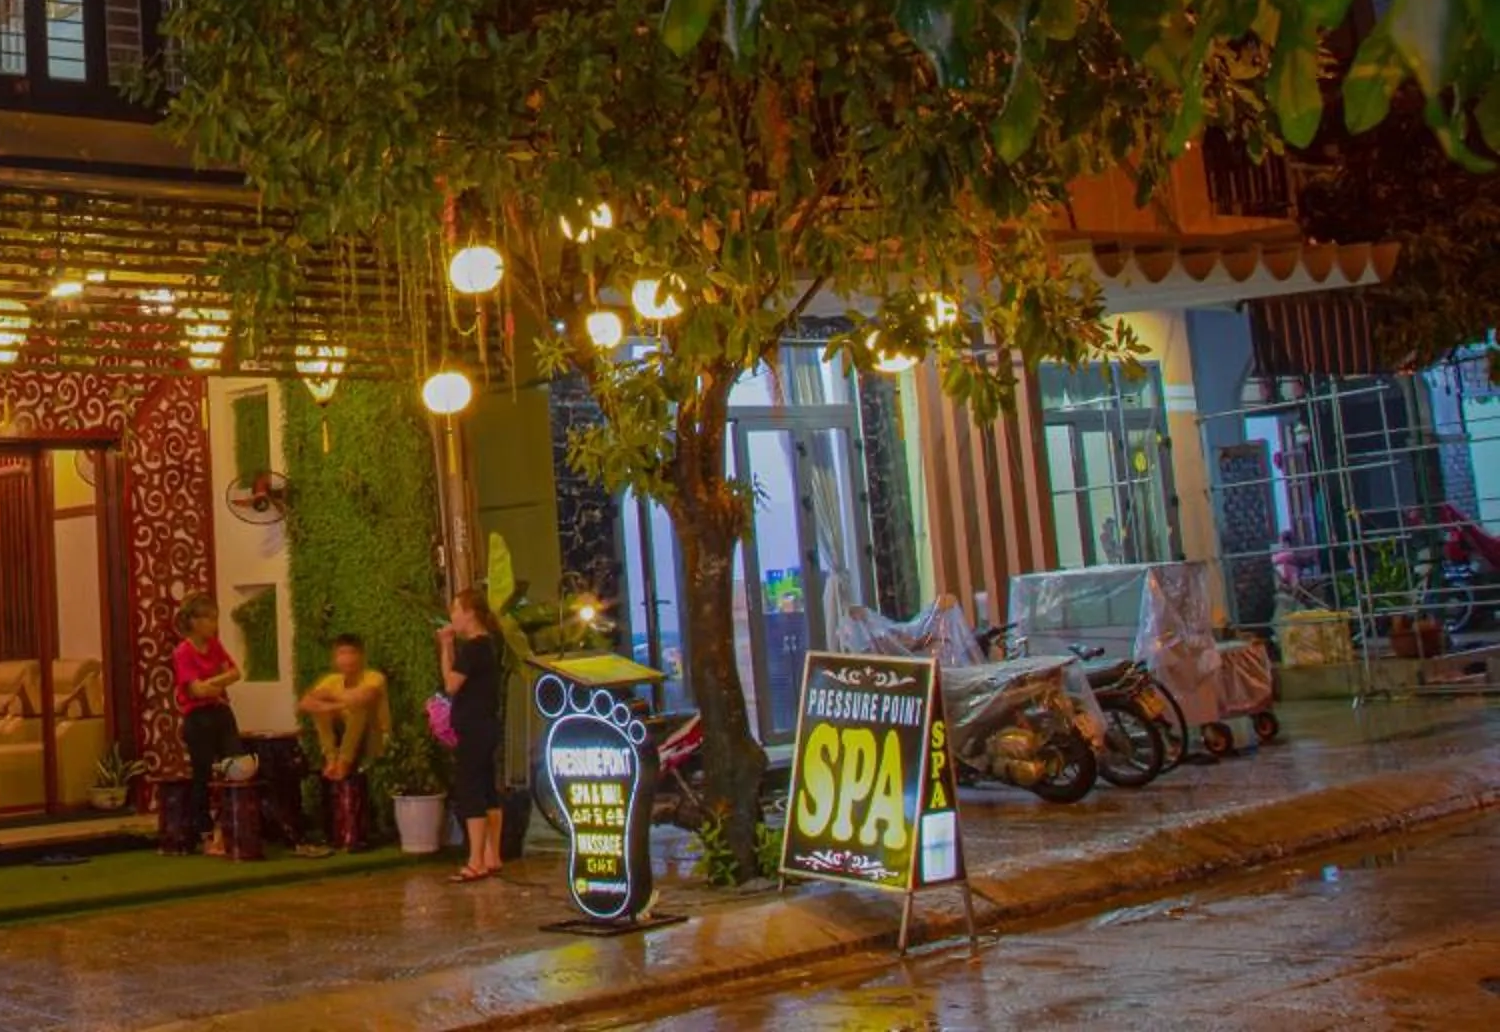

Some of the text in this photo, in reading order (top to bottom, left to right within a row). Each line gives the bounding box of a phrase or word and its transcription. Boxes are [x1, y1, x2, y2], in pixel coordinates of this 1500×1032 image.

[807, 688, 923, 726] PRESSURE POINT
[796, 723, 907, 850] SPA
[929, 720, 947, 809] SPA
